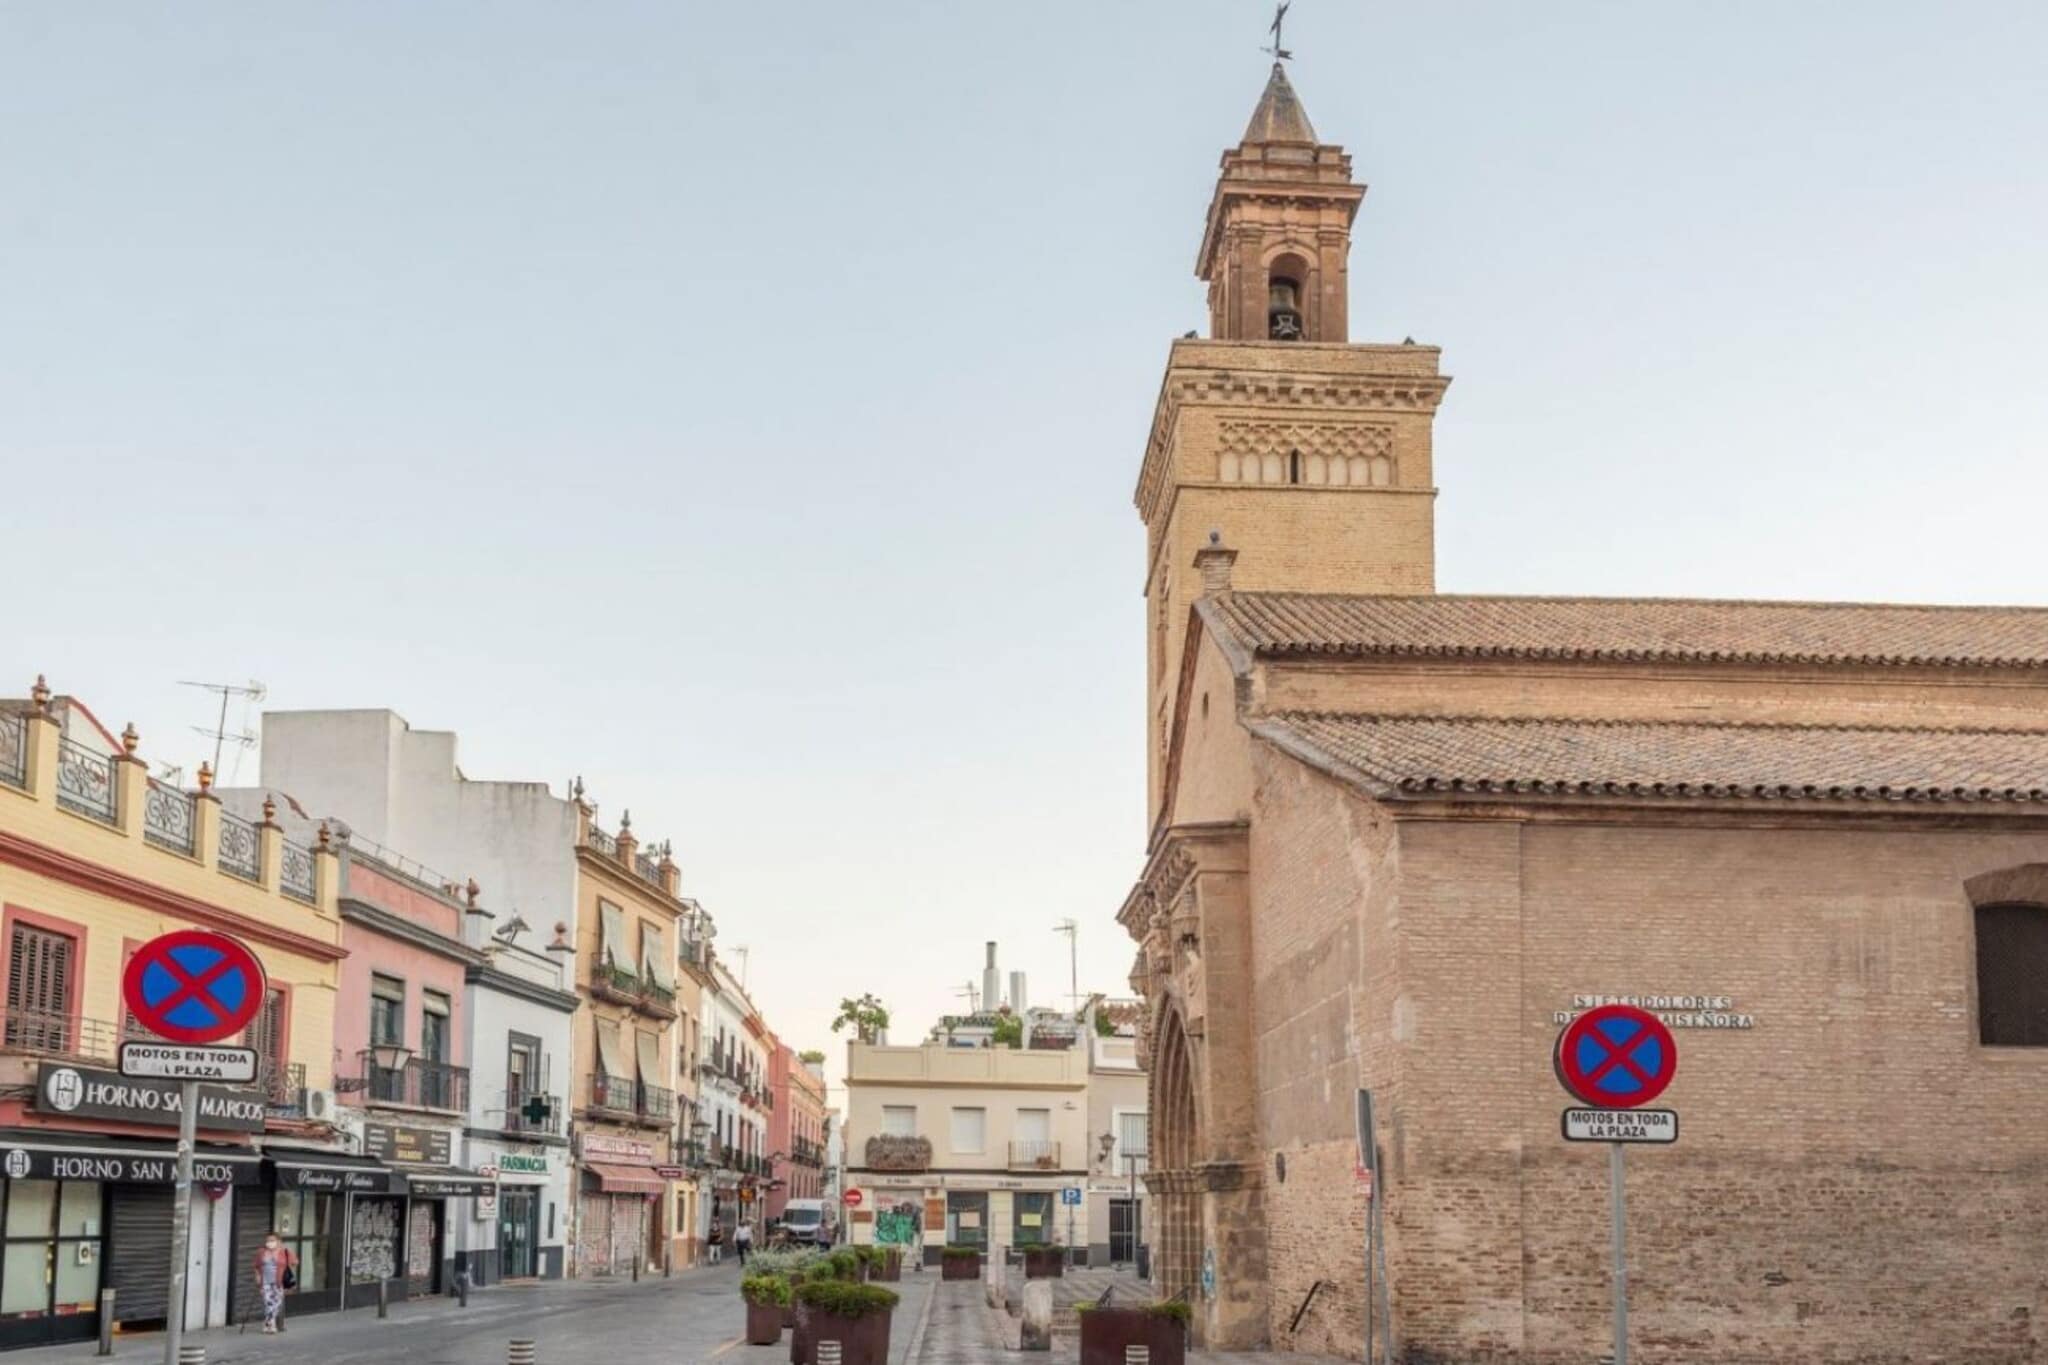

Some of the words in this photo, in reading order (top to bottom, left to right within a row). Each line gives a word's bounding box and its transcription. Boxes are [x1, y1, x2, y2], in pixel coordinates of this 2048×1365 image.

[1644, 996, 1730, 1009] DOLORES
[1678, 1010, 1752, 1026] SEÑORA
[127, 1048, 180, 1060] MOTOS
[185, 1051, 204, 1061] EN
[208, 1053, 247, 1064] TODA
[175, 1065, 222, 1077] PLAZA
[86, 1083, 160, 1110] HORNO
[158, 1092, 184, 1112] SA
[200, 1097, 264, 1121] MARCOS
[1571, 1112, 1613, 1125] MOTOS
[1617, 1114, 1633, 1125] EN
[1636, 1114, 1669, 1126] TODA
[1589, 1126, 1605, 1137] LA
[1608, 1126, 1647, 1137] PLAZA
[53, 1157, 123, 1179] HORNO
[130, 1160, 164, 1181] SAN
[170, 1162, 233, 1181] MRCOS
